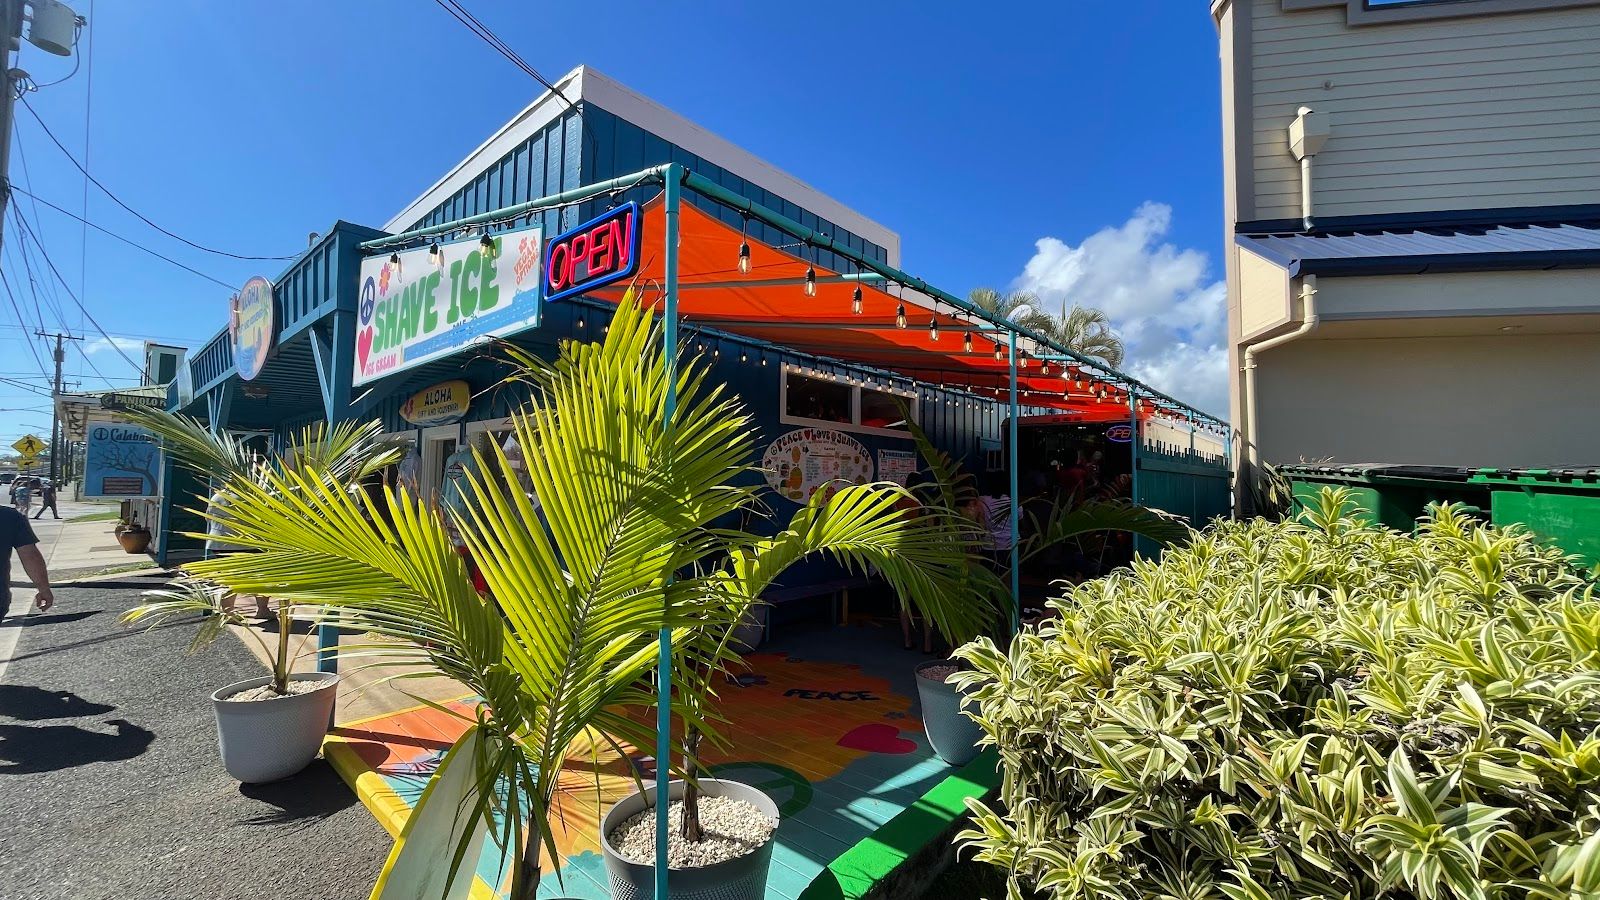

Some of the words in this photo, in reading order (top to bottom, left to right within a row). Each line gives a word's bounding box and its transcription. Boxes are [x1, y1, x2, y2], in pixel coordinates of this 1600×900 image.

[514, 236, 537, 275] VEGAN
[549, 213, 632, 290] OPEN
[372, 271, 441, 353] SHAVE
[447, 236, 502, 324] ICE
[366, 361, 375, 376] ICE
[376, 353, 397, 372] CREAM
[114, 395, 158, 406] PANIOLO
[424, 387, 452, 406] ALOHA
[776, 431, 803, 452] PEACE
[811, 429, 830, 441] LOVE
[837, 434, 858, 450] SHAVE
[859, 446, 869, 461] ICE
[1106, 429, 1131, 438] OPE
[783, 689, 880, 701] PEACE
